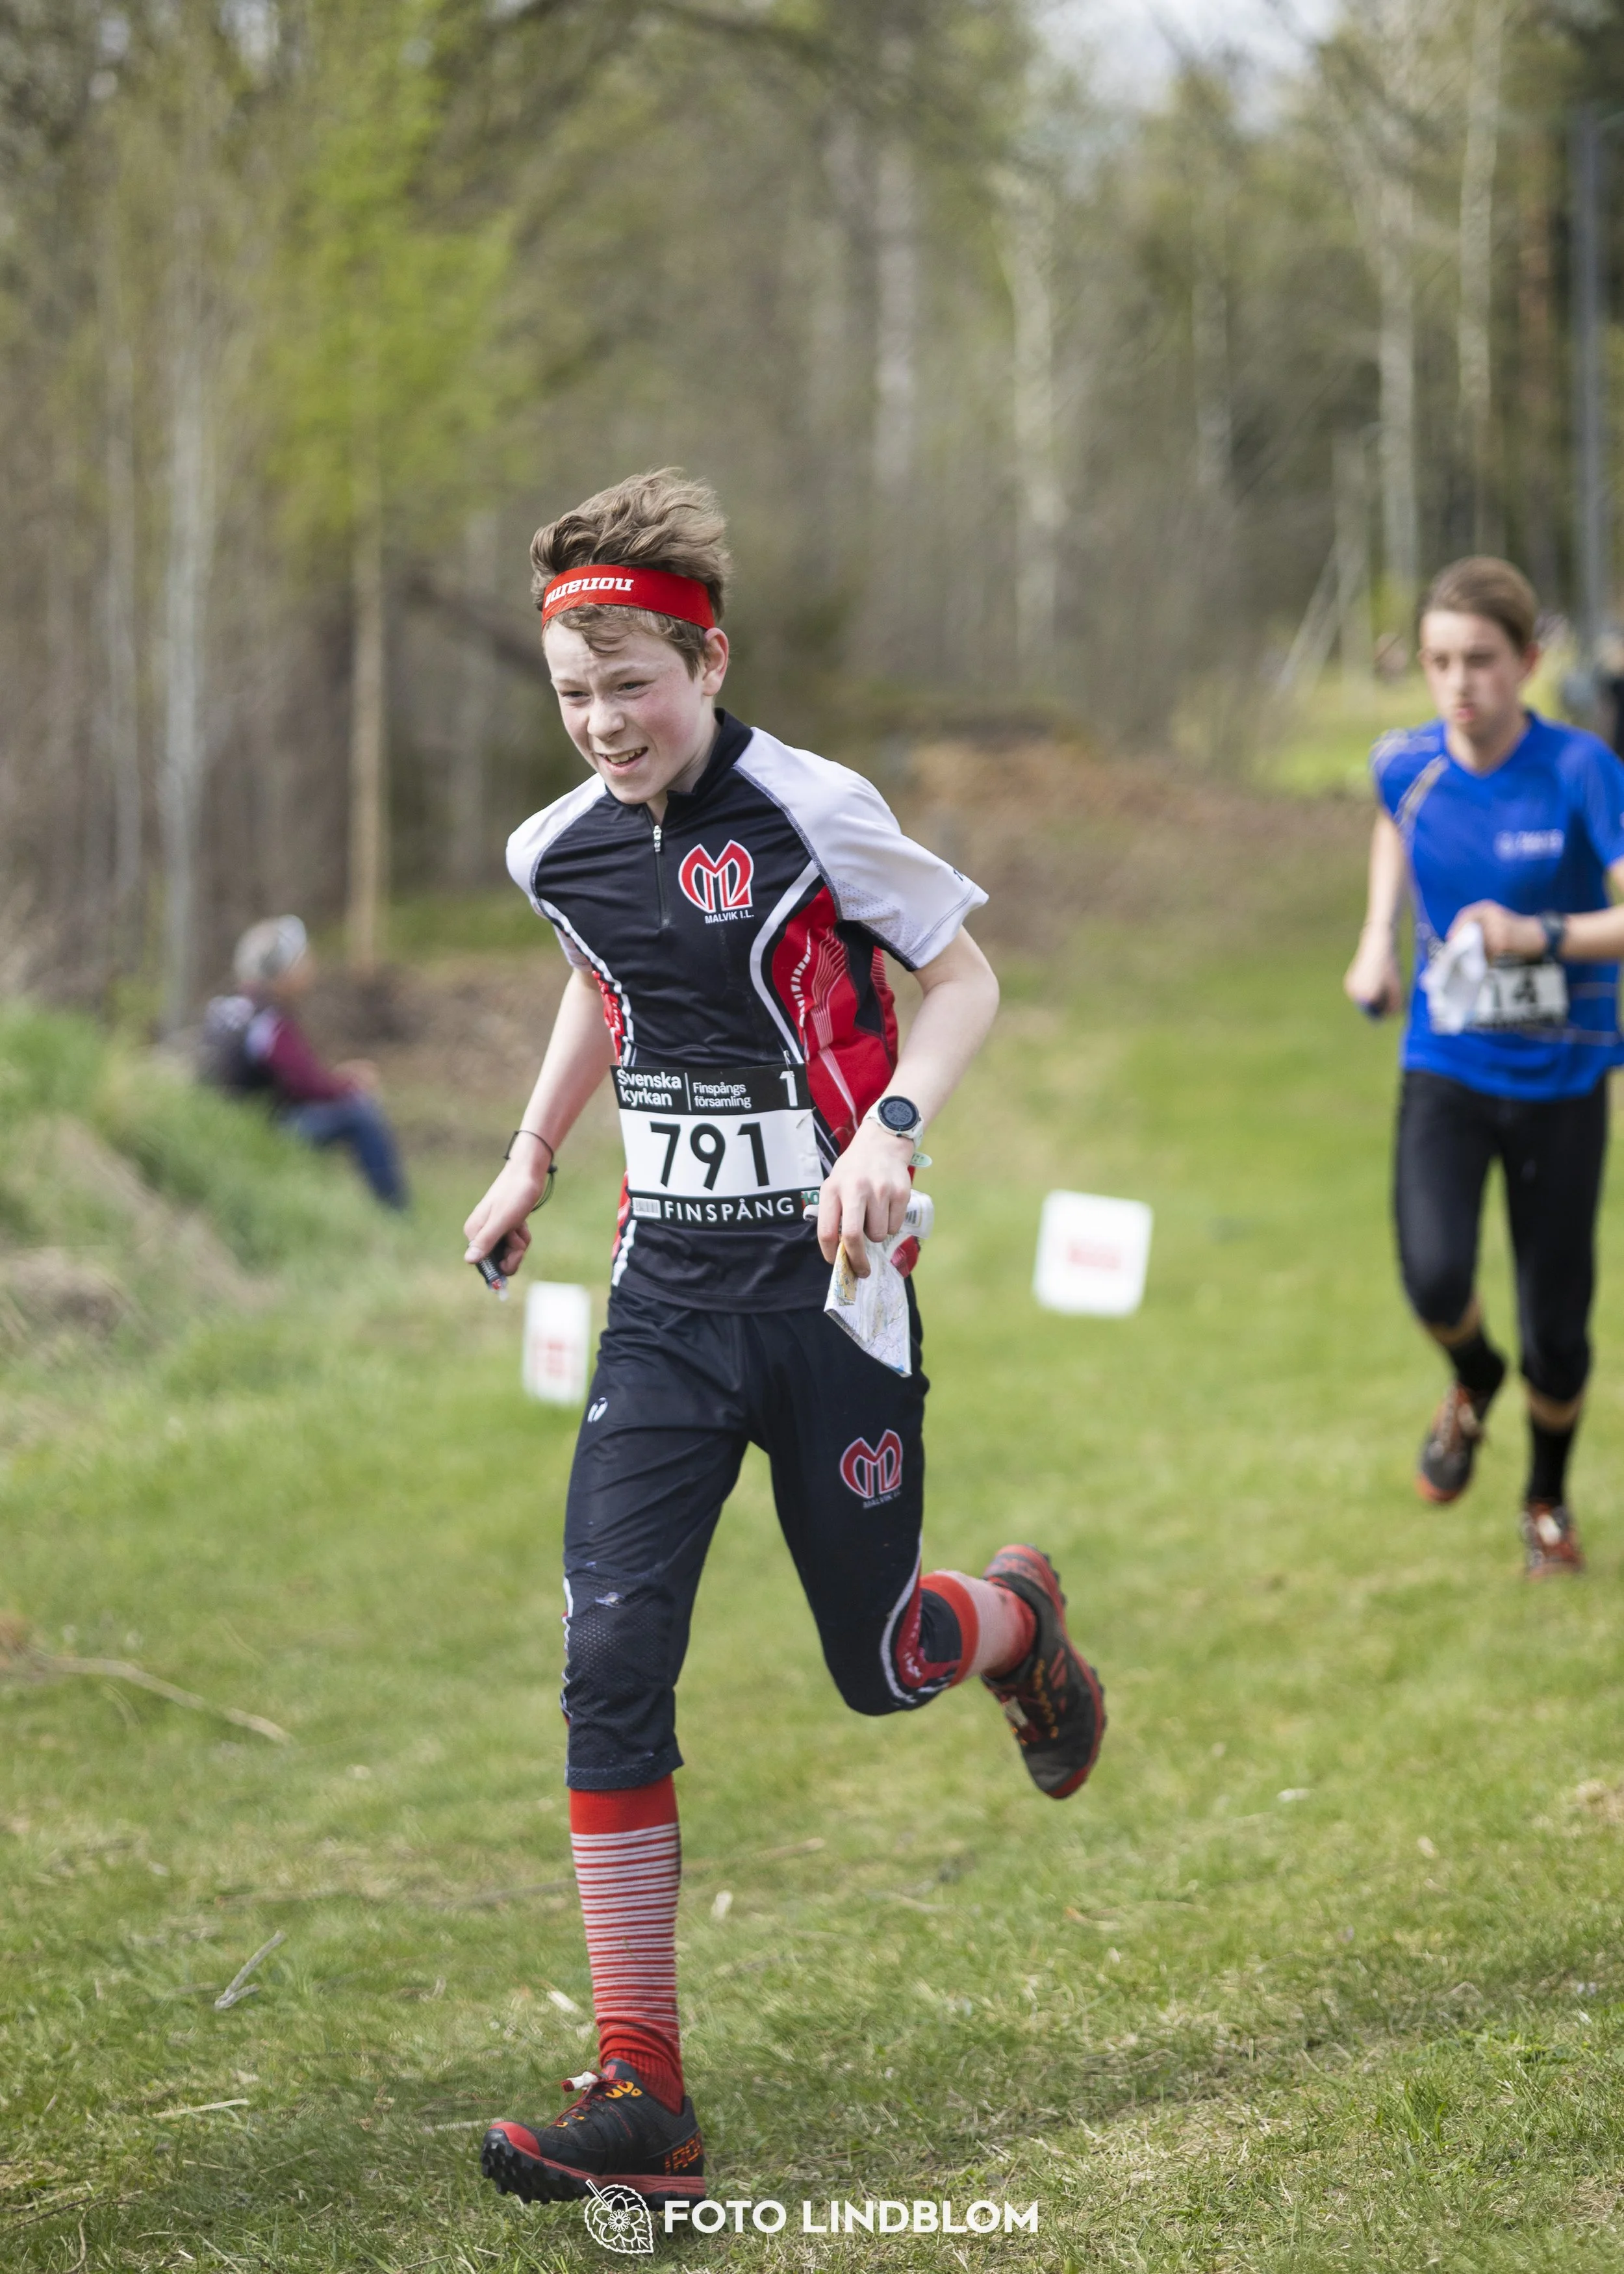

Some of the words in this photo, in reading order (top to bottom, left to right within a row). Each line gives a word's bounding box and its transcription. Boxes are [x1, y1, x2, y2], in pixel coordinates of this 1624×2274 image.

[705, 912, 738, 924] MALVIK
[616, 1069, 682, 1090] Svenska
[692, 1081, 747, 1097] Finspångs
[780, 1070, 798, 1106] 1
[620, 1086, 672, 1108] kyrkan
[694, 1095, 752, 1109] församling
[650, 1121, 770, 1191] 791
[664, 1197, 794, 1221] FINSPÅNG
